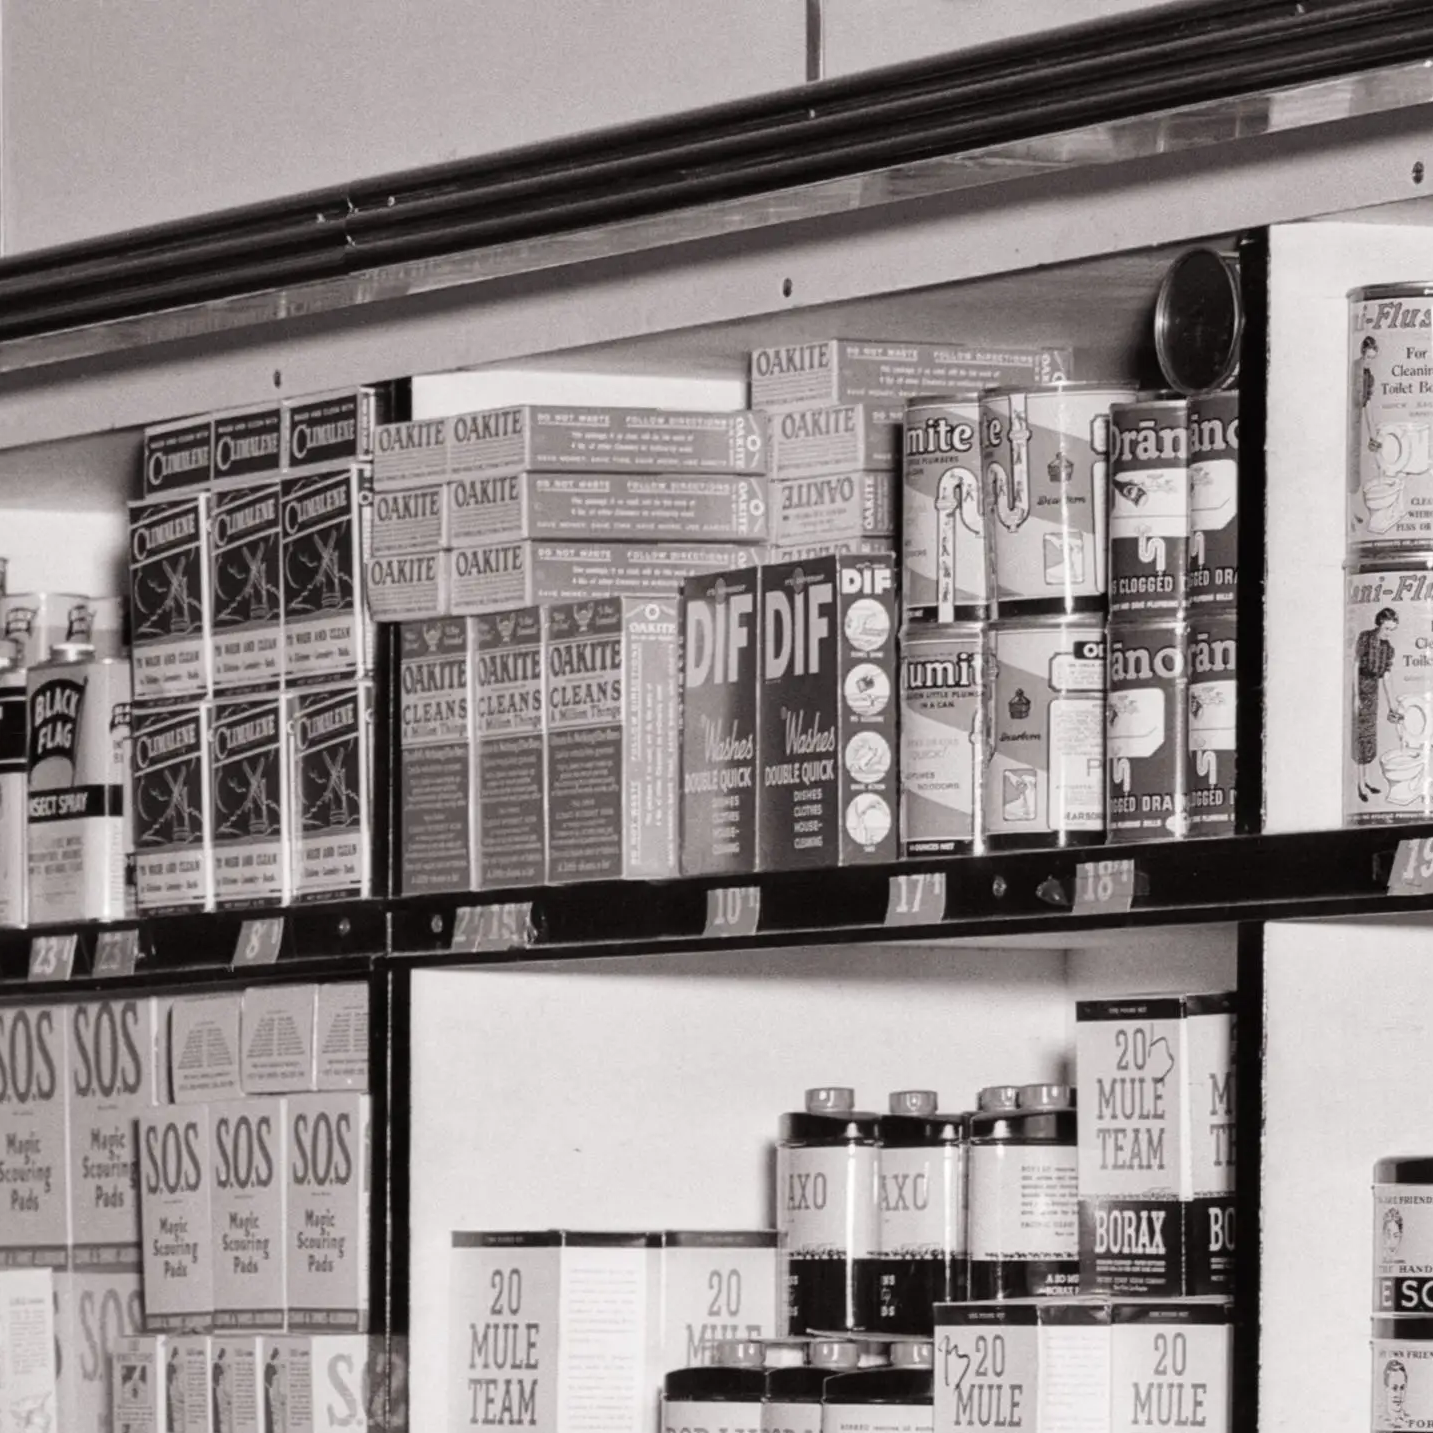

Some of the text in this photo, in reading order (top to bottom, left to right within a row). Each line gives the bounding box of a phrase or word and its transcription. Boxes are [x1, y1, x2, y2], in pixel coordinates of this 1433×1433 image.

[756, 348, 831, 376] OAKITE
[1406, 348, 1427, 360] For
[1381, 382, 1413, 395] Toilet
[292, 417, 356, 459] CLIMALENE
[454, 411, 524, 442] OAKITE
[286, 482, 351, 534] CLIMALENE
[842, 567, 892, 592] DIF
[766, 585, 832, 678] DIF
[549, 641, 621, 679] OAKITE
[549, 680, 621, 712] CLEANS
[764, 760, 835, 786] DOUBLE QUICK
[5, 1133, 40, 1159] Magic
[10, 1187, 40, 1212] Pads
[489, 1270, 522, 1314] 20
[469, 1324, 540, 1370] MULE
[1153, 1333, 1187, 1375] 20
[468, 1379, 538, 1425] TEAM
[1132, 1382, 1206, 1427] MULE
